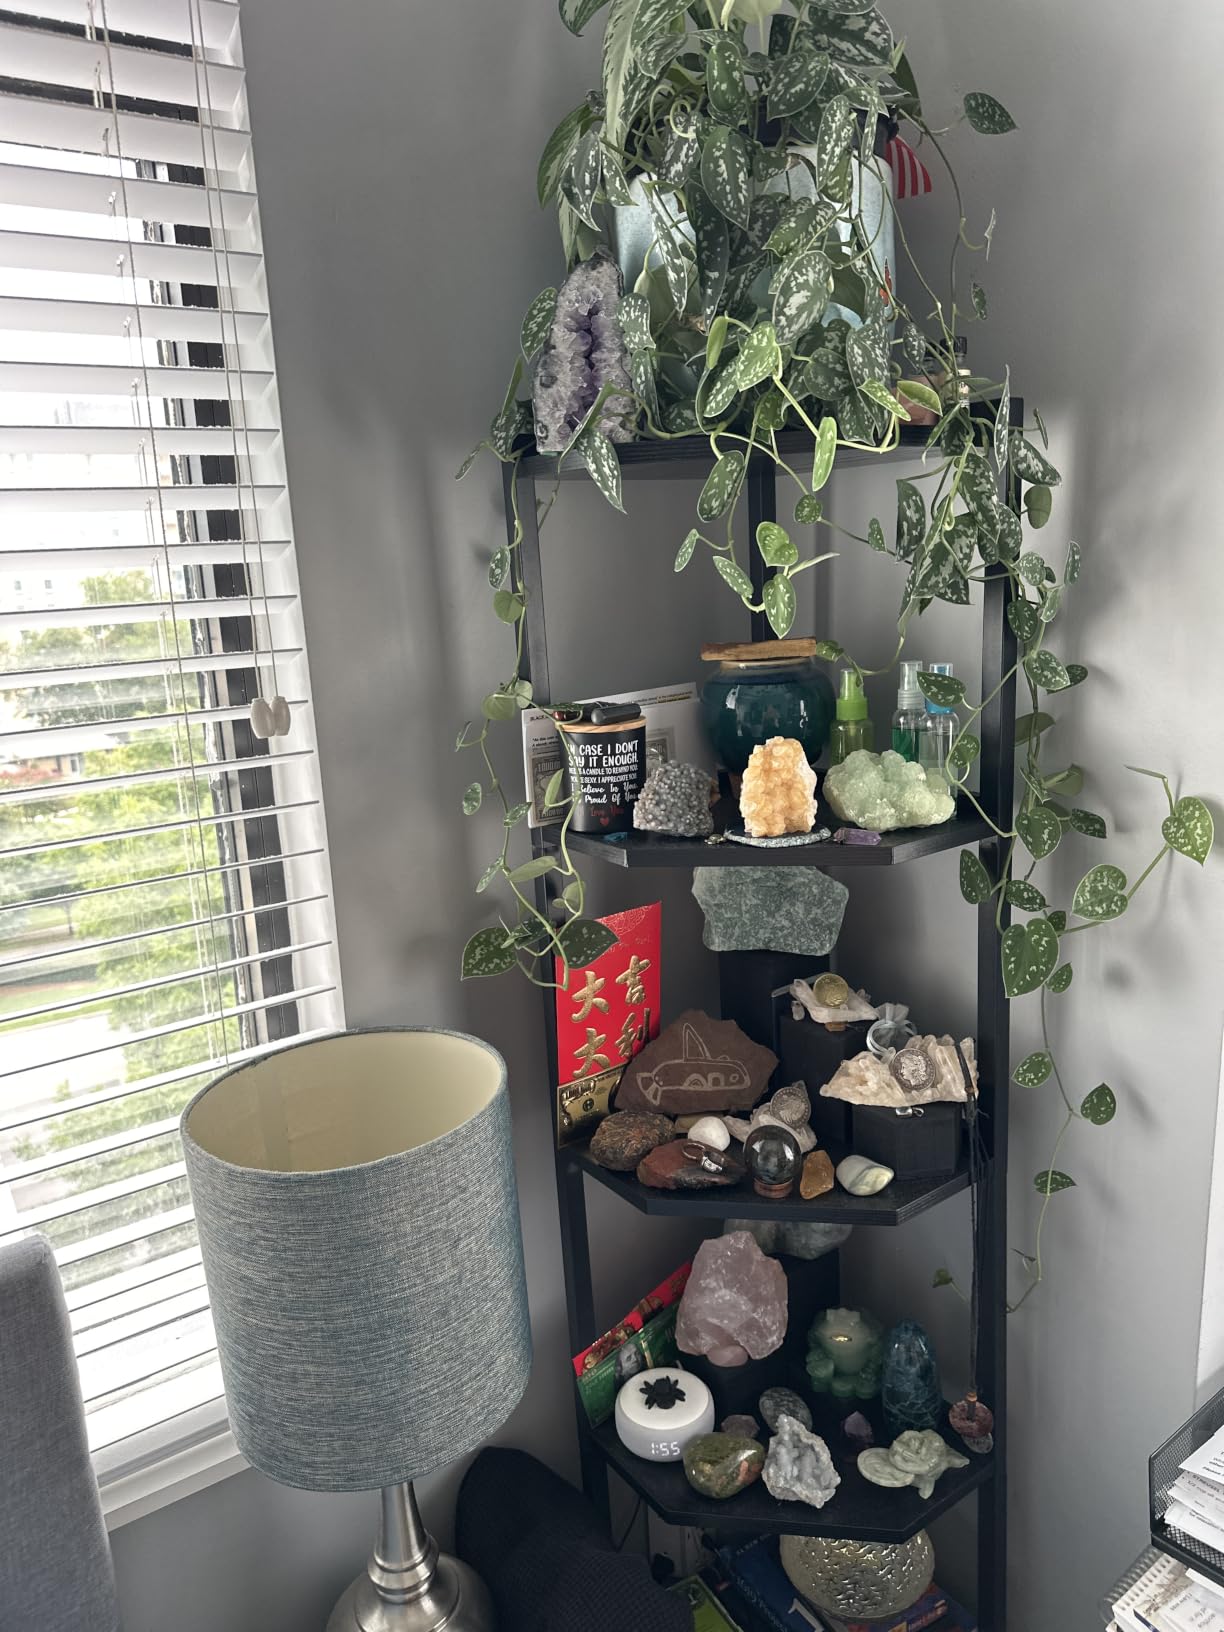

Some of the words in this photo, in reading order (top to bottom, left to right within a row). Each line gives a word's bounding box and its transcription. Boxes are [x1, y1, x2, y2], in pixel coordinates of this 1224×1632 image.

[579, 744, 603, 756] CASE
[607, 743, 611, 755] I
[615, 739, 639, 754] DON'T
[589, 756, 599, 768] IT
[602, 752, 639, 767] ENOUGH.
[586, 768, 605, 776] CANDLE
[613, 765, 630, 774] REMIND
[601, 774, 629, 784] APPRECIATE
[584, 794, 608, 804] Proud
[651, 1441, 681, 1457] 1:55
